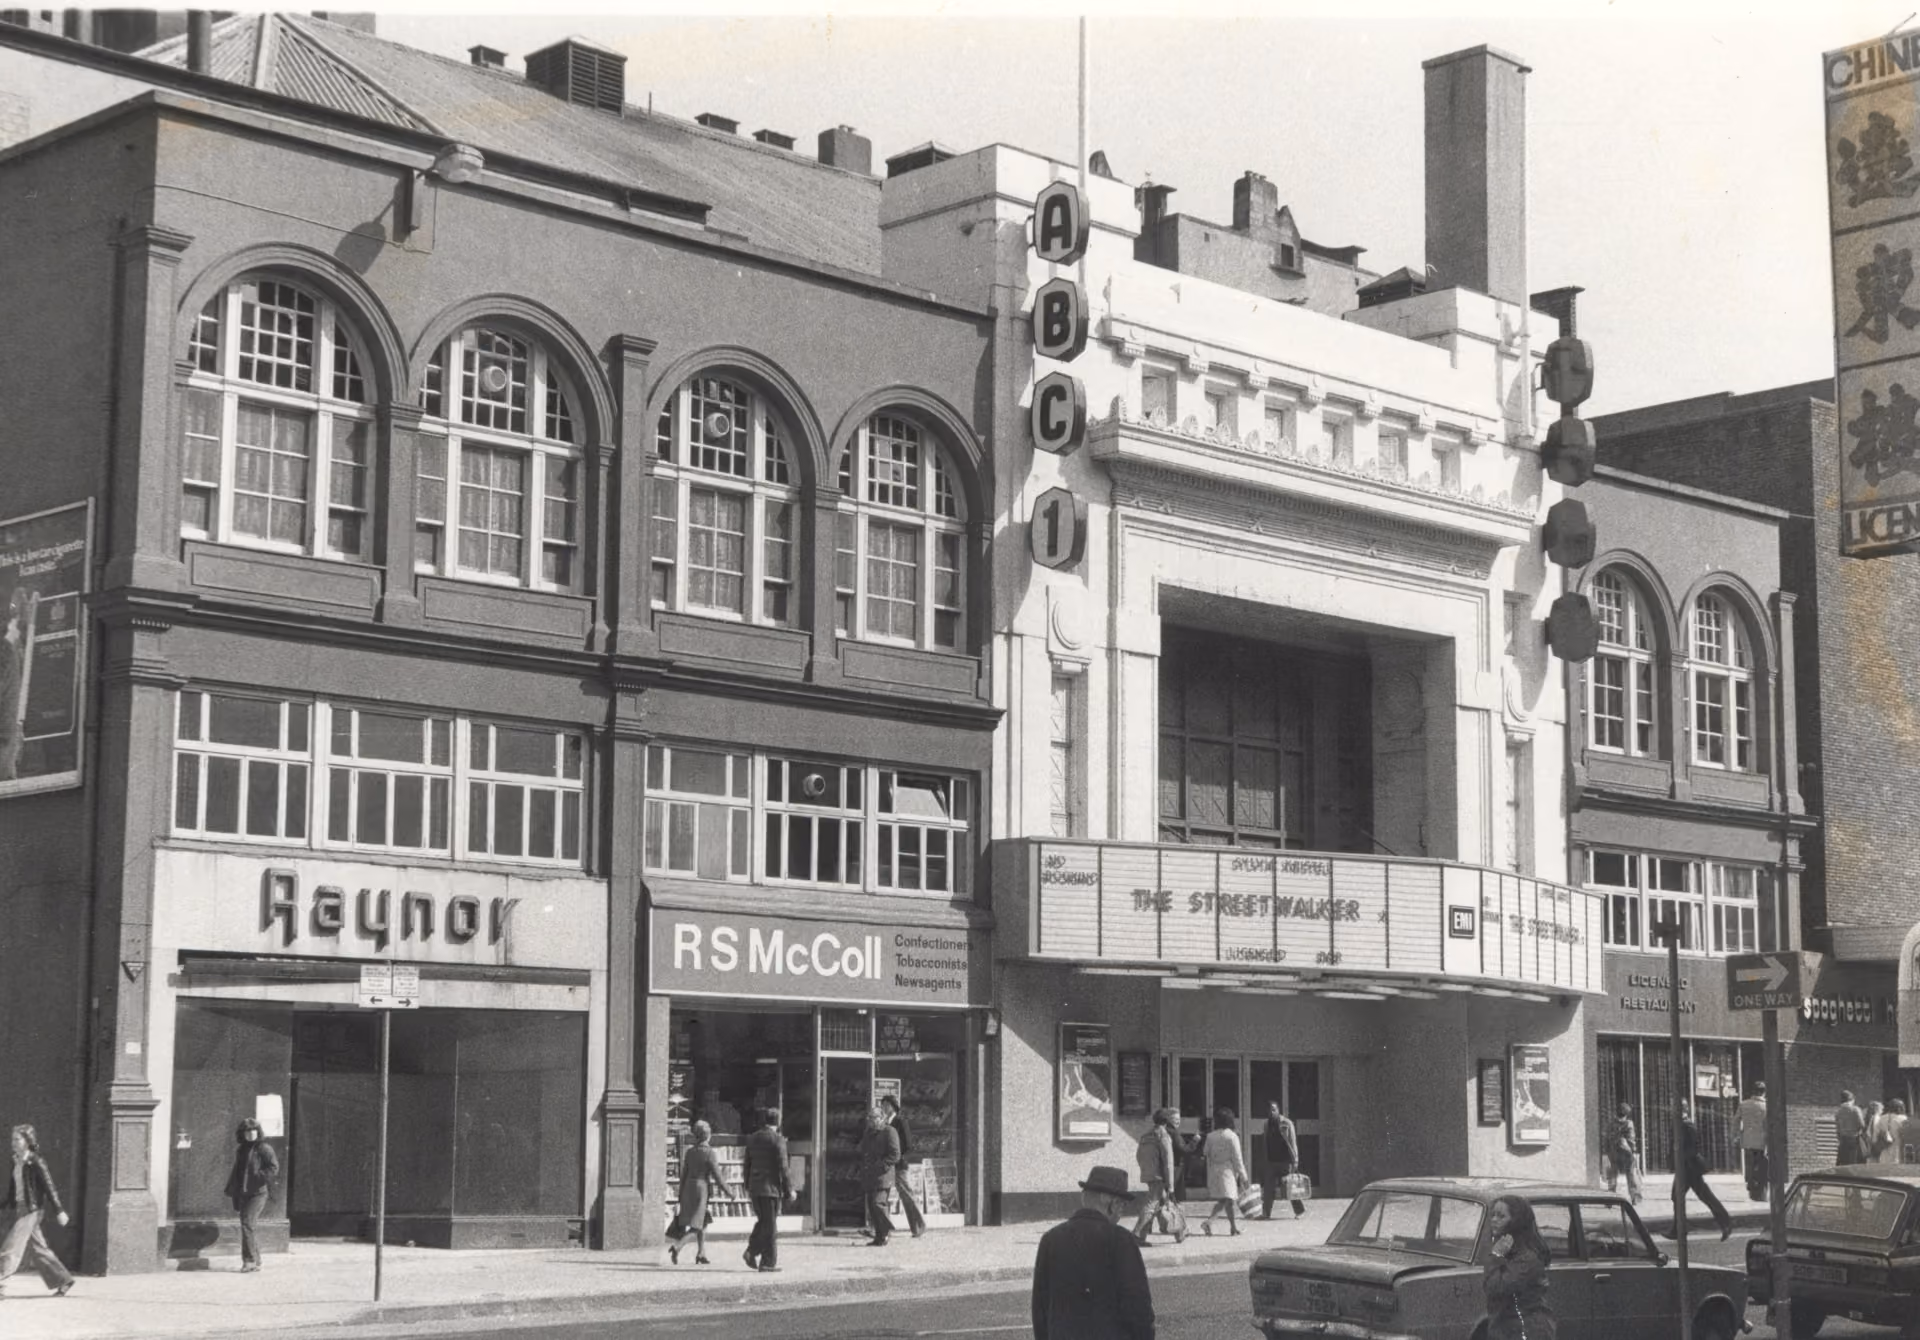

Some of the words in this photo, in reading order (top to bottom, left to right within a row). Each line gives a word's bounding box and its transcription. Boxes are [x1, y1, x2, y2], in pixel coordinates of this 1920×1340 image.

[1043, 500, 1060, 557] 1
[259, 867, 522, 953] Raynor
[1131, 889, 1173, 913] THE
[1453, 911, 1473, 931] EMI
[895, 934, 974, 951] Confectioners
[749, 928, 881, 979] McColl
[896, 953, 967, 970] Tobacconists
[895, 974, 962, 992] Newsagents
[1629, 974, 1689, 990] LICENSD
[1621, 997, 1698, 1014] RESTAUANT
[1734, 994, 1762, 1008] ONE
[1764, 993, 1793, 1006] WAY
